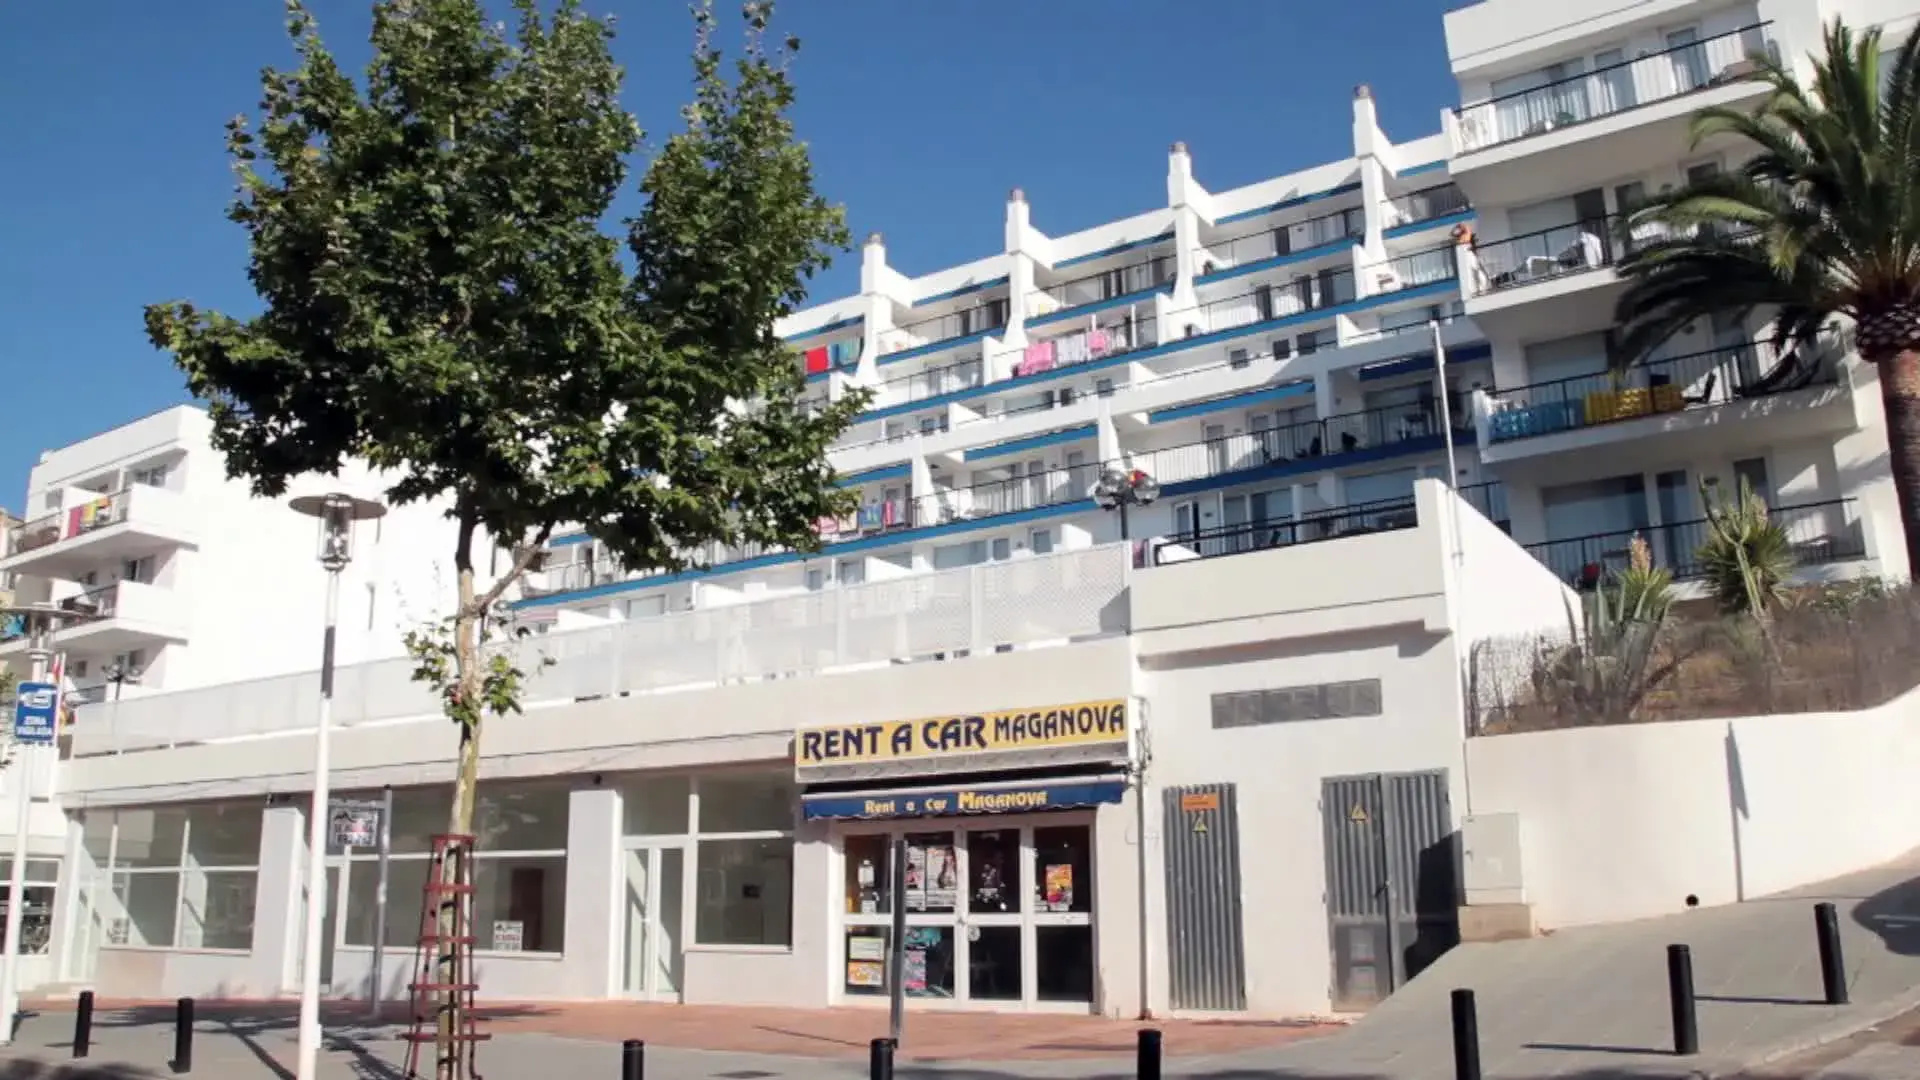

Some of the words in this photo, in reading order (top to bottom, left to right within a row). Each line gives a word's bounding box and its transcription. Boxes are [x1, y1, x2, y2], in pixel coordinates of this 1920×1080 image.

[802, 726, 883, 761] RENT
[892, 723, 913, 755] A
[922, 716, 988, 751] CAR
[994, 703, 1125, 743] MAGANOVA
[865, 799, 896, 814] Rent
[924, 798, 948, 811] Car
[958, 791, 1048, 810] MAGANOVA
